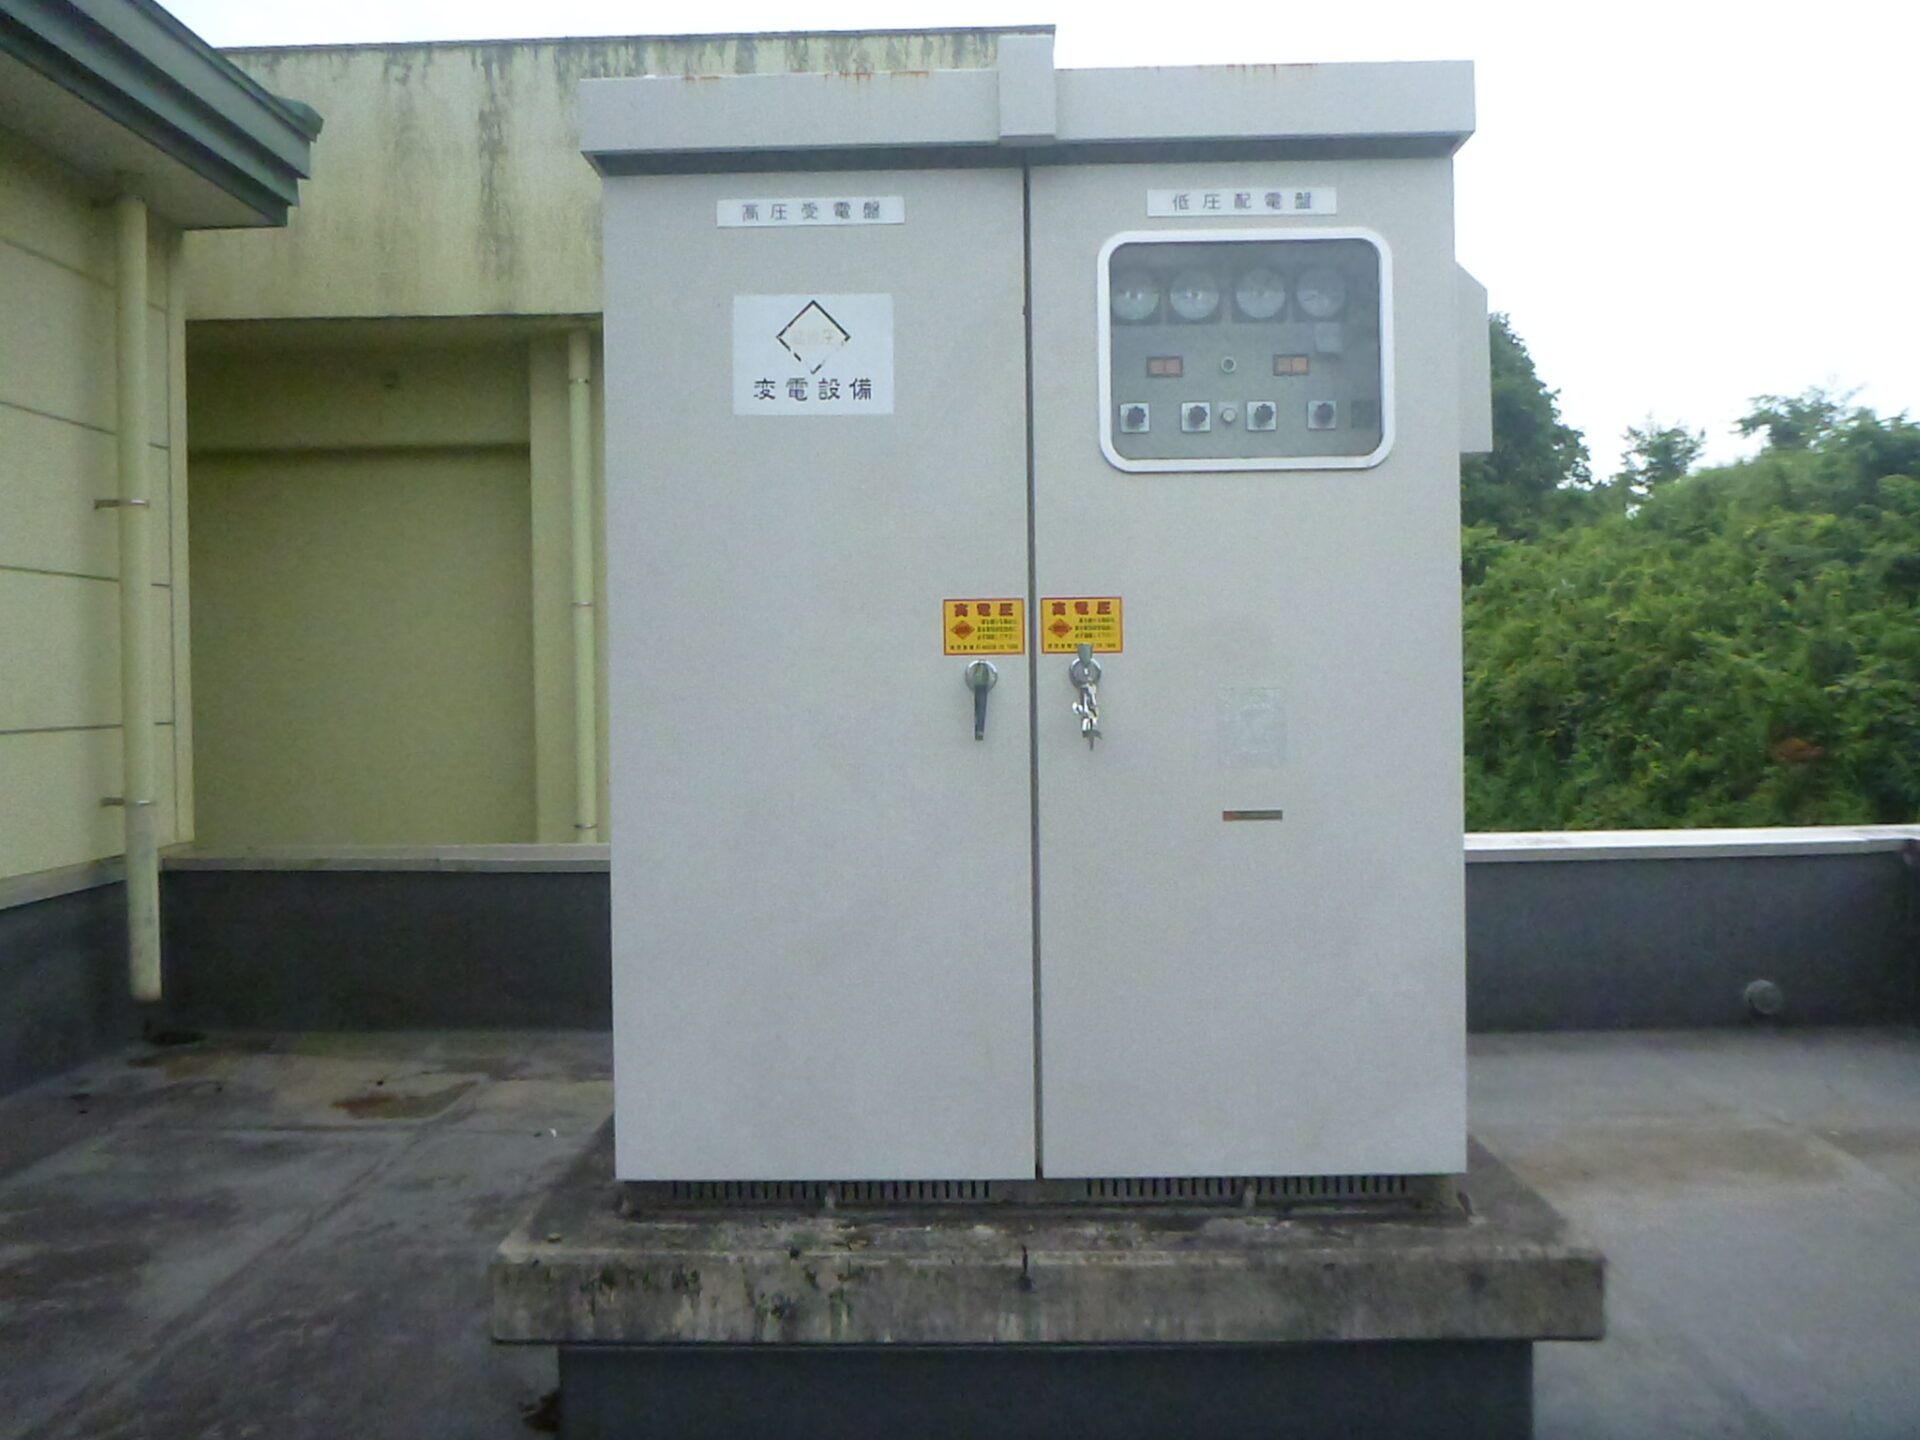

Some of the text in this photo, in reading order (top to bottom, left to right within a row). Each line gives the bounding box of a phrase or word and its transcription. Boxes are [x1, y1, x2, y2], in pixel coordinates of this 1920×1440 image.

[742, 201, 880, 221] 高圧受電盤
[1173, 192, 1312, 211] 低圧配電盤
[753, 378, 872, 401] 変電設備
